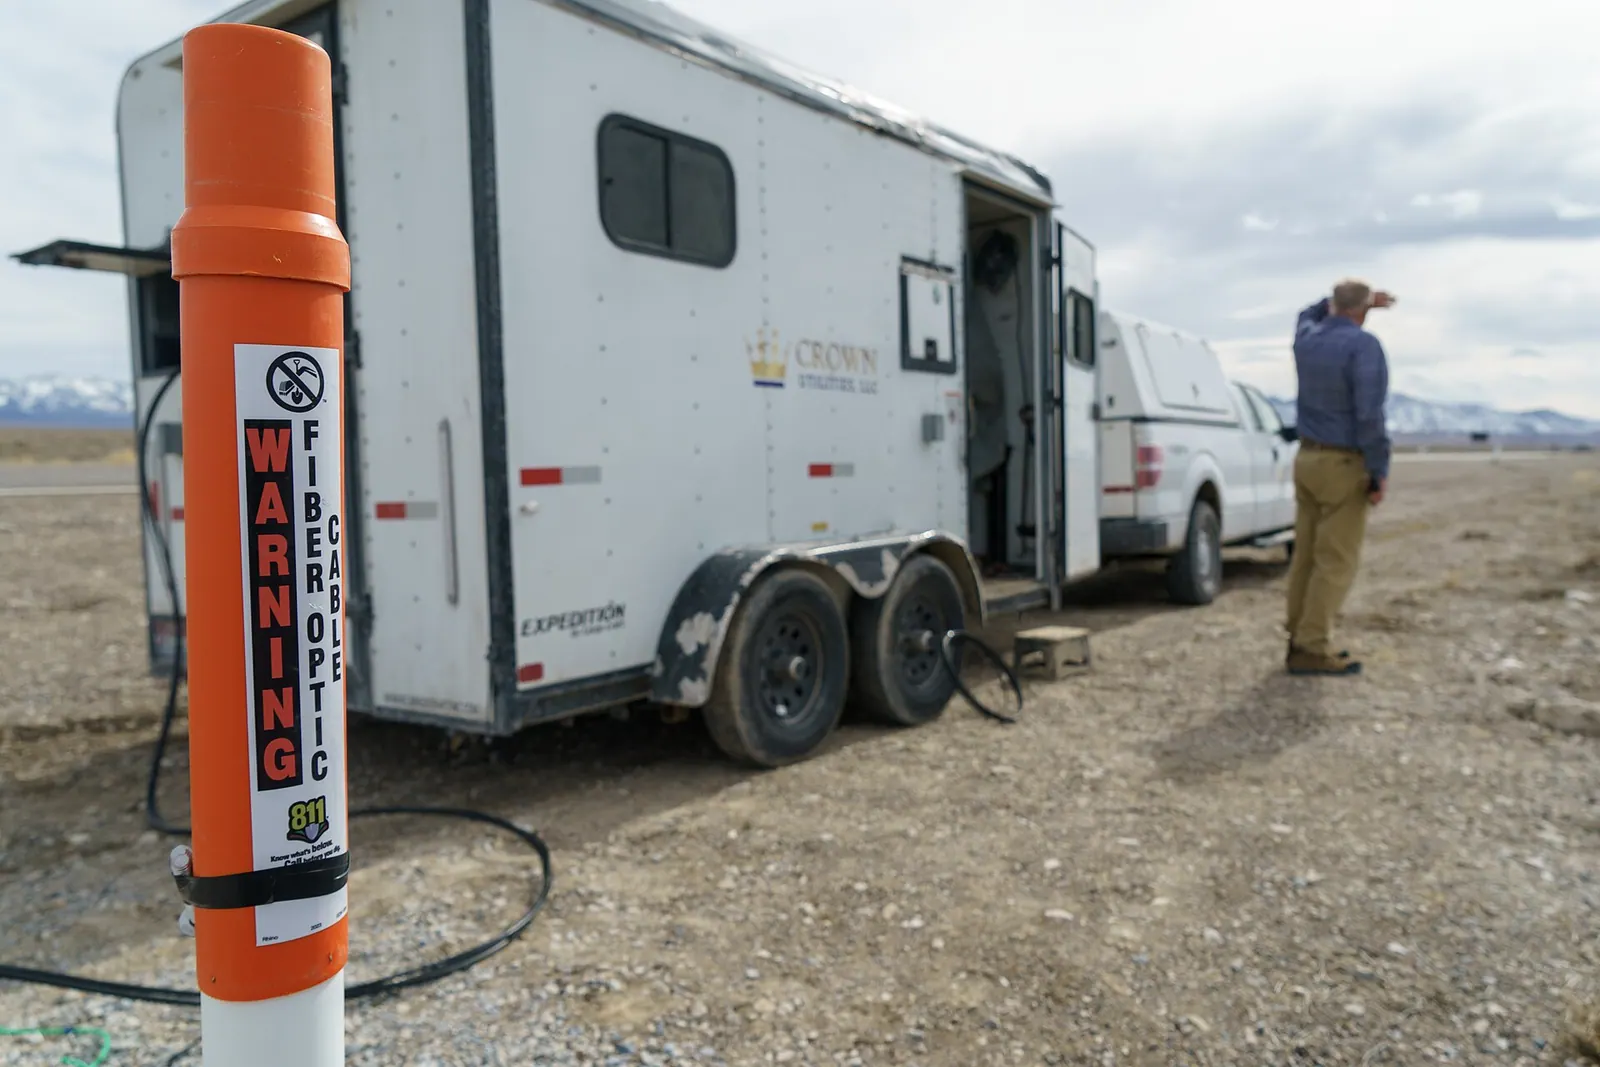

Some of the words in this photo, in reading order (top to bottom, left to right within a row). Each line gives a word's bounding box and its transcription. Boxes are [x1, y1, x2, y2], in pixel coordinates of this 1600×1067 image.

[795, 338, 878, 375] CROWN
[303, 419, 324, 594] FIBER
[246, 428, 297, 781] WARNING
[328, 514, 342, 683] CABLE
[521, 601, 626, 637] EXPEDITION
[306, 612, 328, 782] OPTIC
[270, 853, 292, 863] Know
[290, 796, 326, 831] 811
